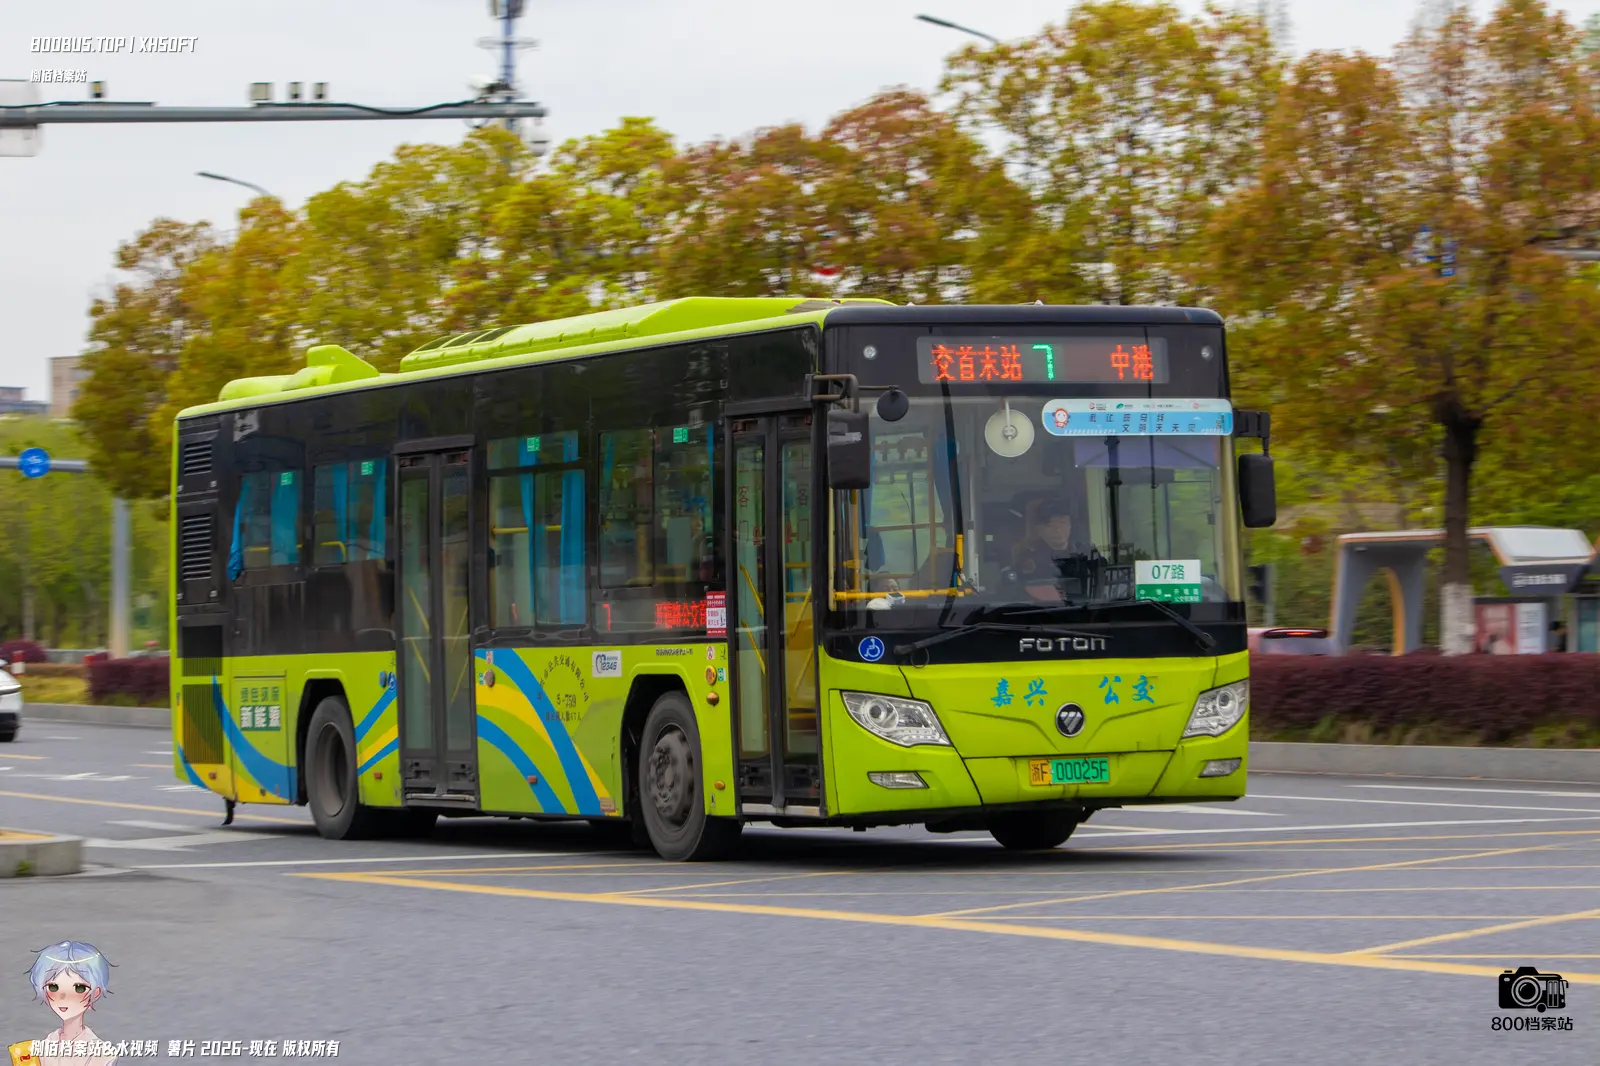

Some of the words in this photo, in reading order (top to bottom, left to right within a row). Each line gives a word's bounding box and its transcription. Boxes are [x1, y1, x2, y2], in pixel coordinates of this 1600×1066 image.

[931, 344, 1023, 381] 交首末站
[1032, 344, 1055, 381] 7
[1151, 564, 1185, 580] 07路
[1019, 637, 1106, 652] FOTON
[990, 677, 1048, 708] 嘉兴
[1098, 675, 1155, 704] 公交
